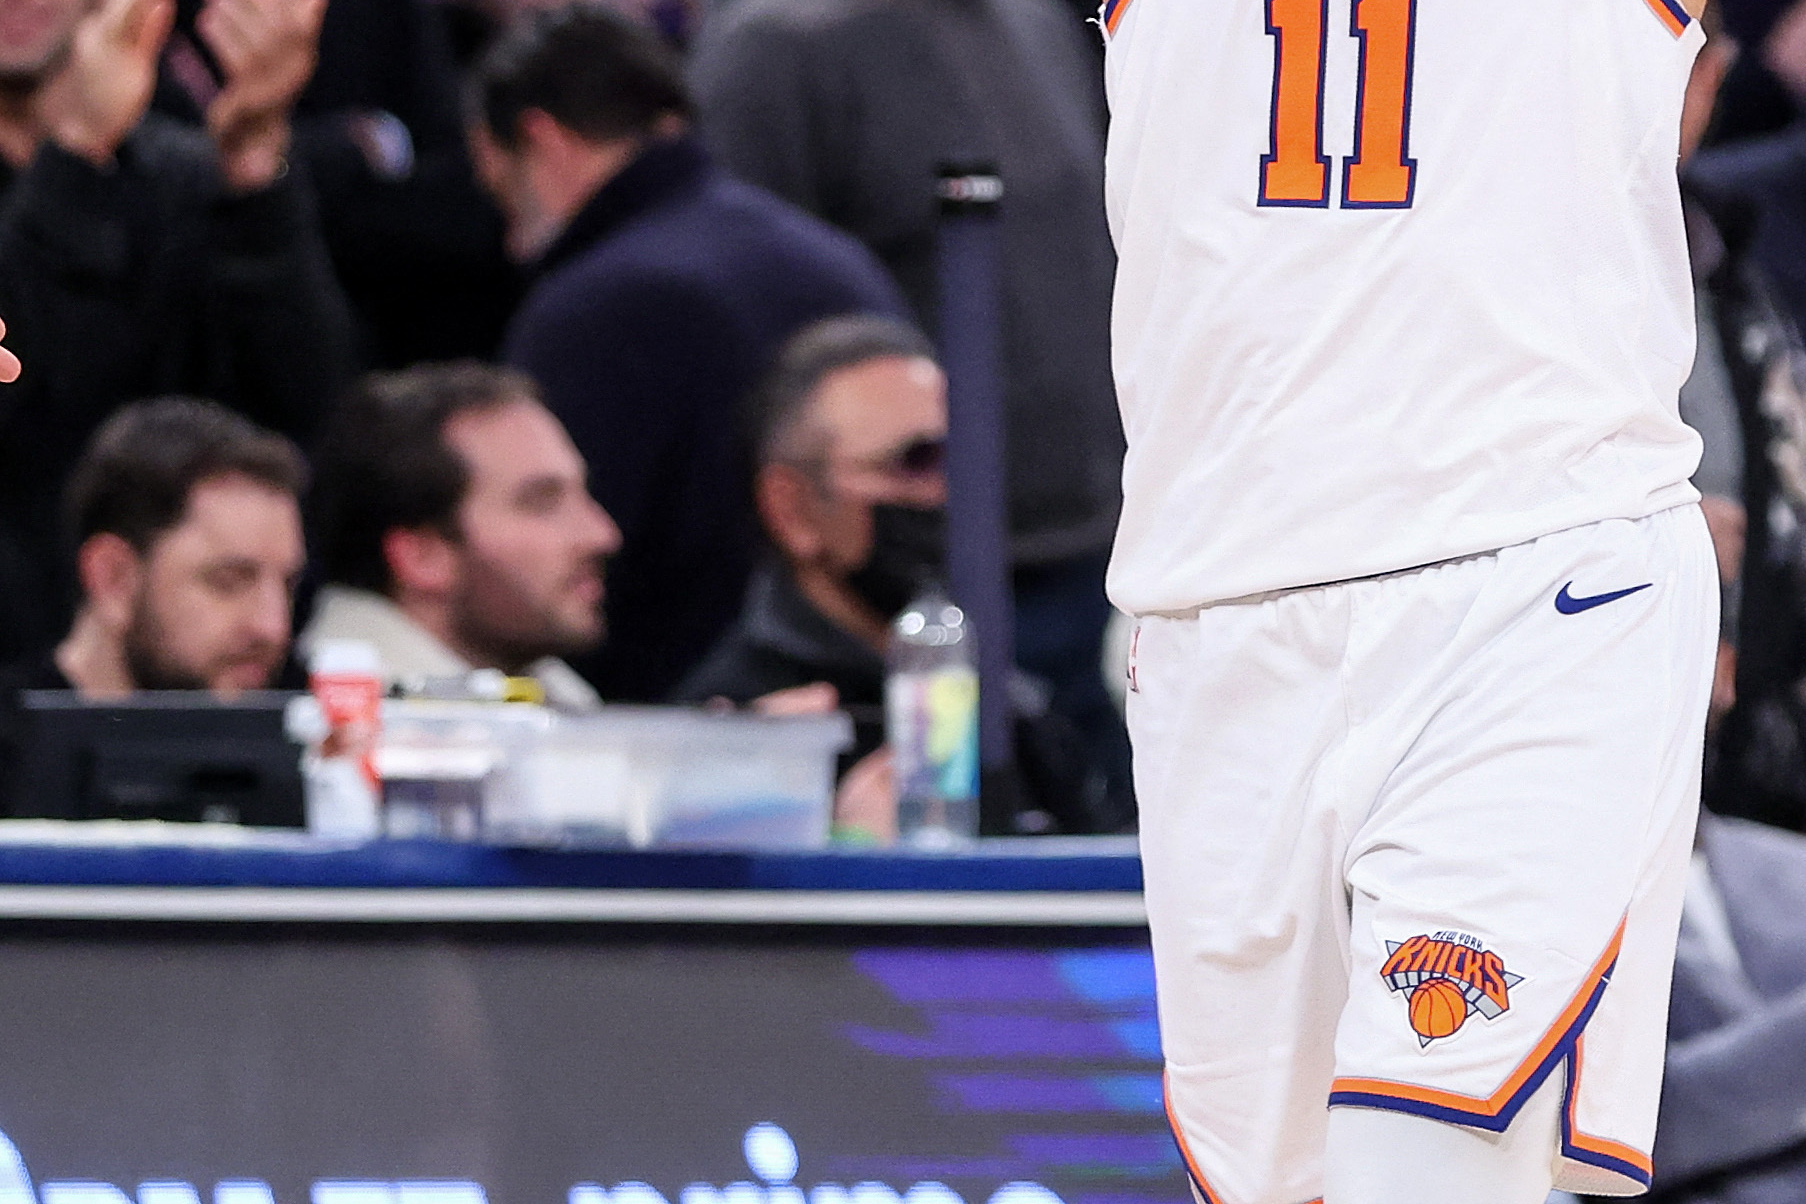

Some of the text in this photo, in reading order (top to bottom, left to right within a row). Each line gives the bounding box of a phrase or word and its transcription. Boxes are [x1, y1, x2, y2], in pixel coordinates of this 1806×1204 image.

[1432, 930, 1483, 952] NEW YORK
[1380, 934, 1510, 1011] KNICKS
